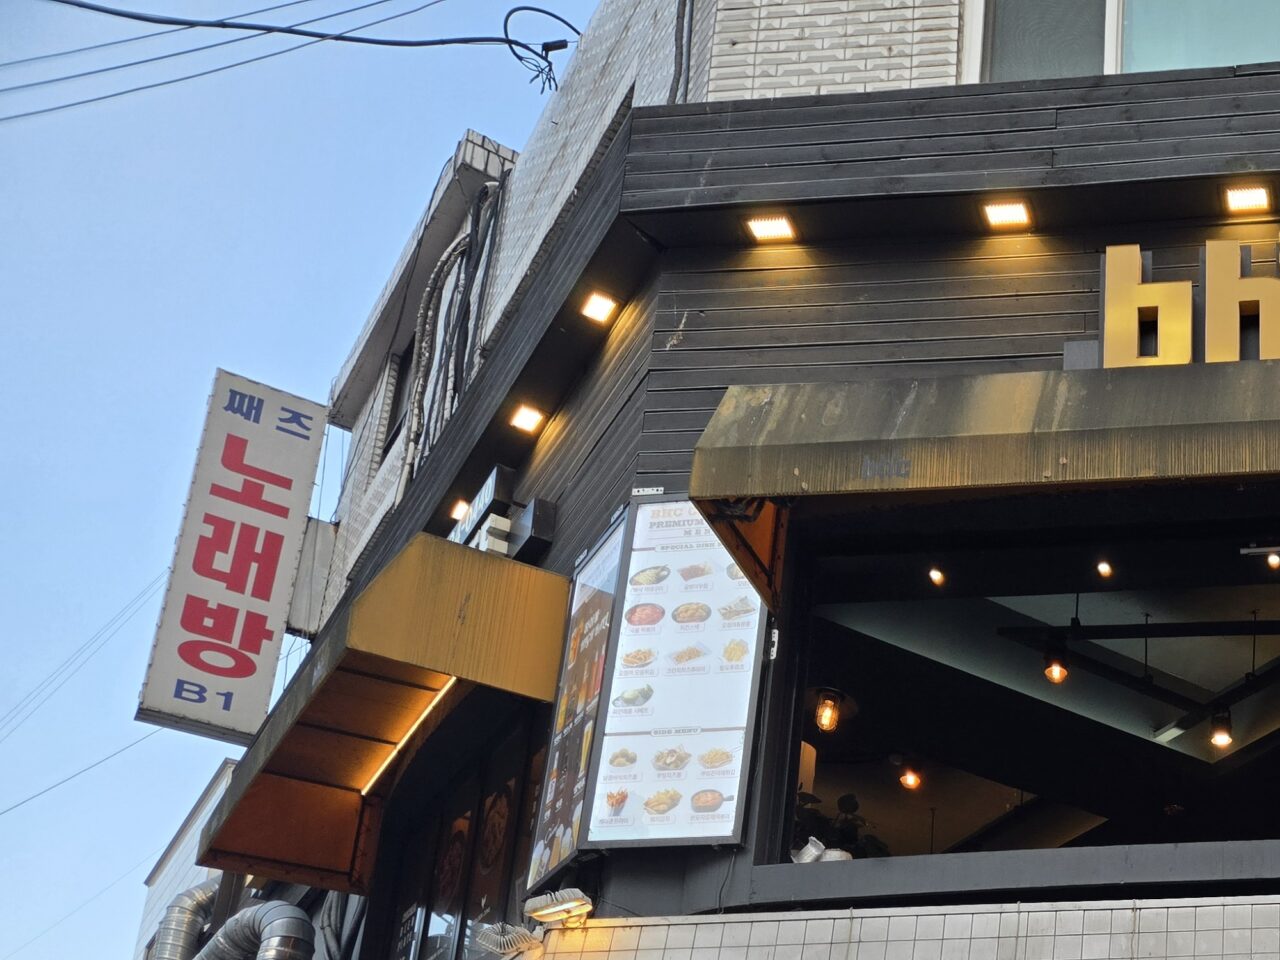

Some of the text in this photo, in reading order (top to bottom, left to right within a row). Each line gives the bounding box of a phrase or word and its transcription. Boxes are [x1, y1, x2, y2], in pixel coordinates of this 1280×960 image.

[648, 519, 705, 529] PREMIUM
[683, 528, 712, 537] MEN
[176, 433, 296, 680] 노래방
[172, 679, 234, 712] B1
